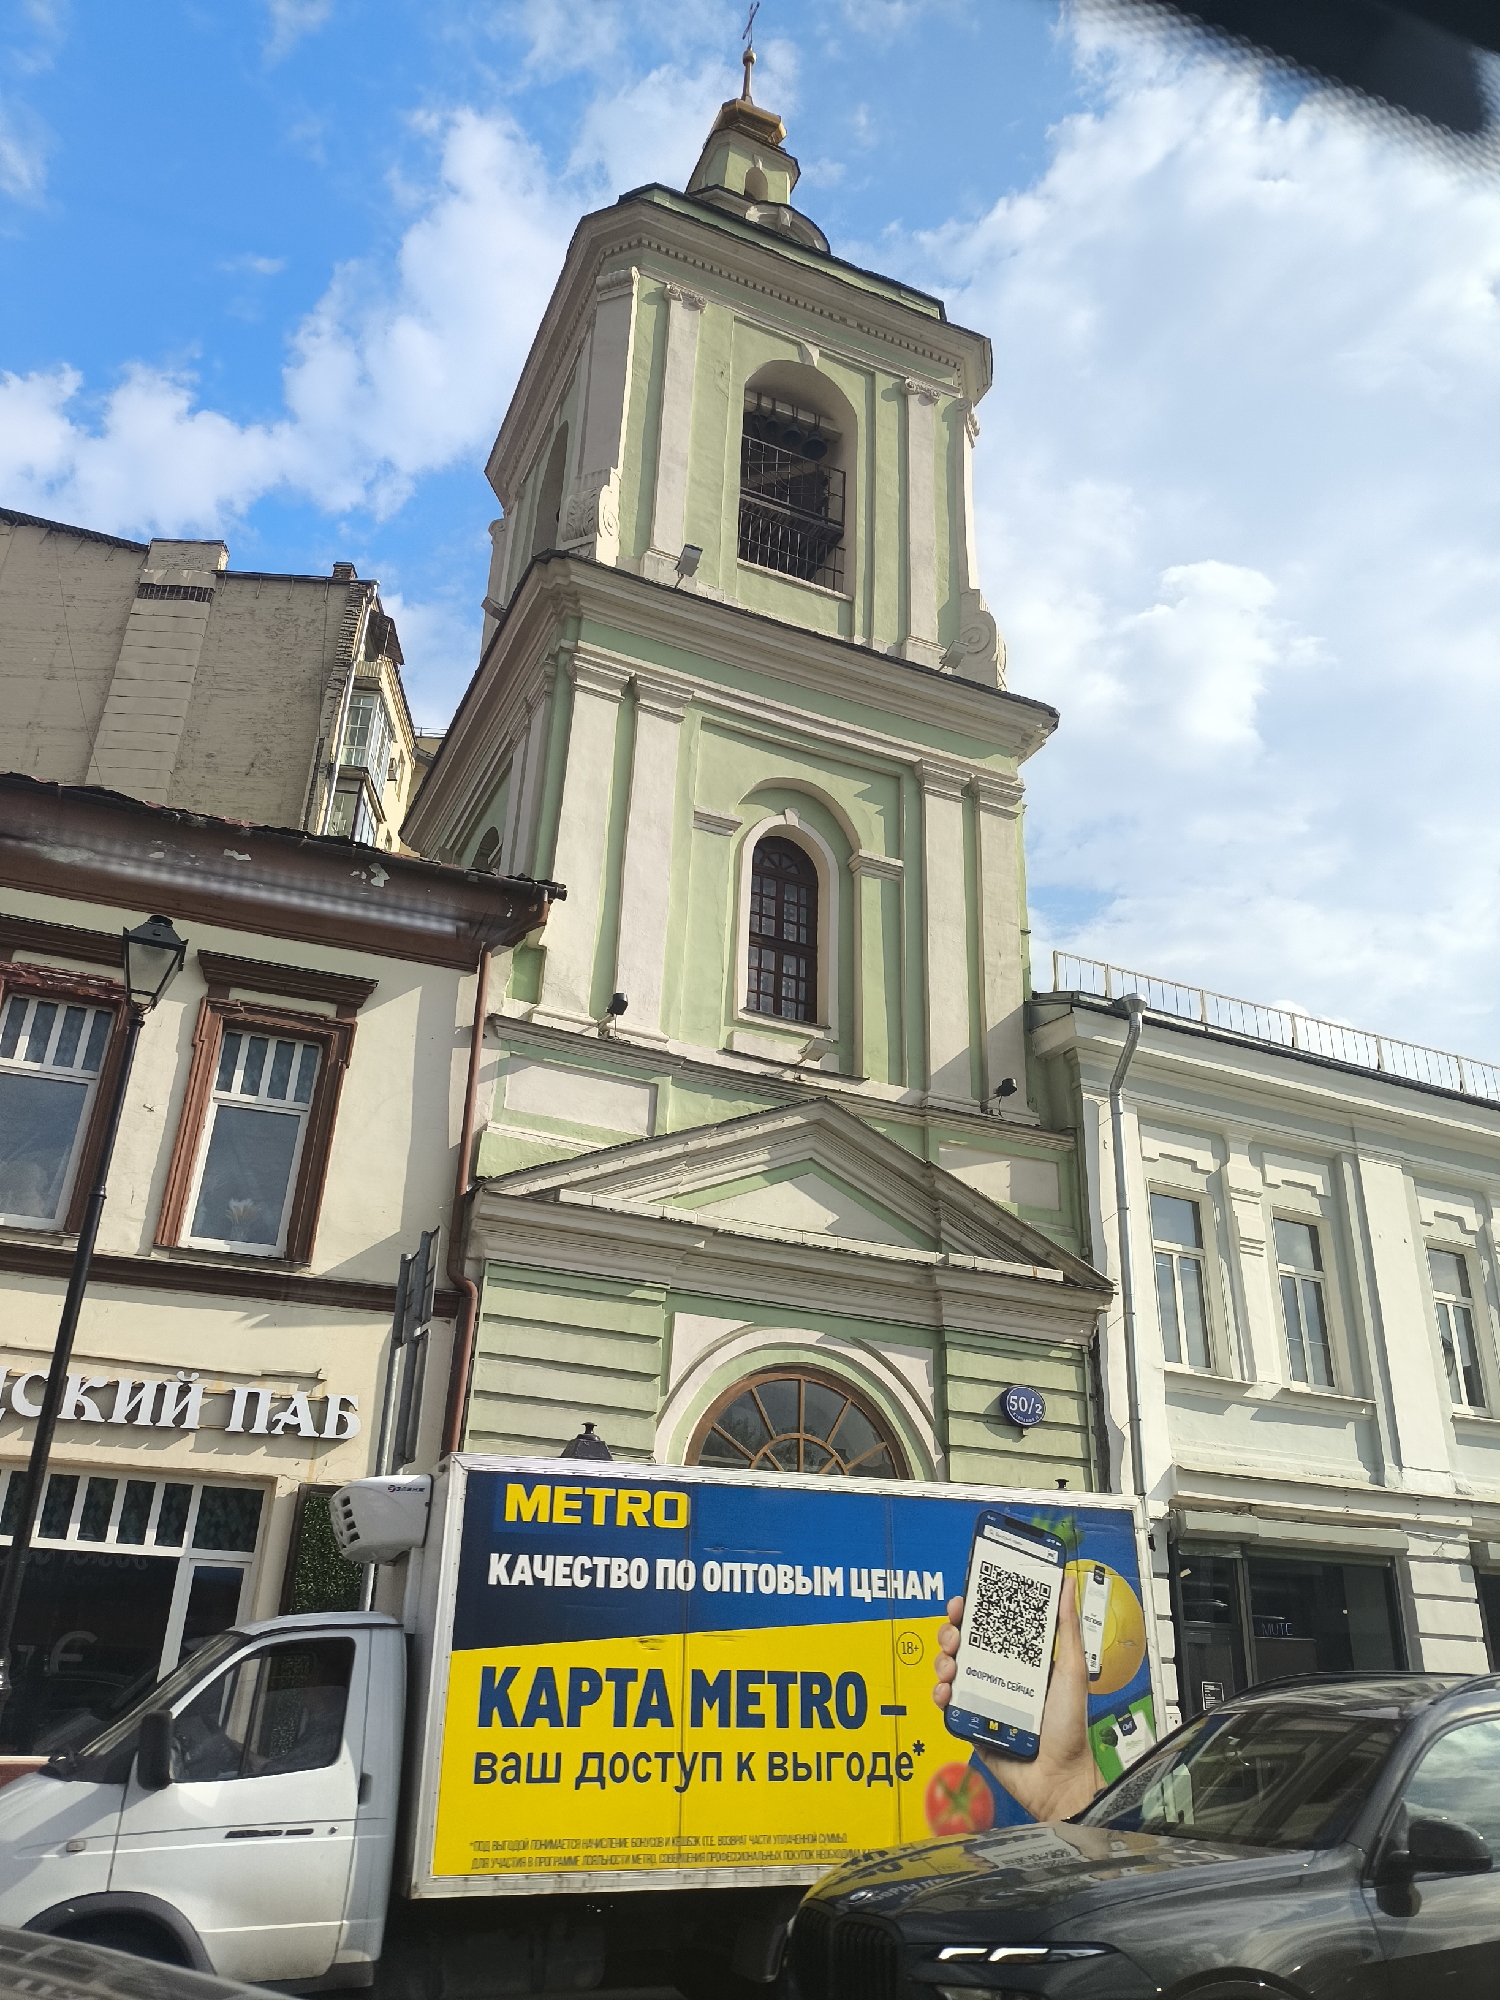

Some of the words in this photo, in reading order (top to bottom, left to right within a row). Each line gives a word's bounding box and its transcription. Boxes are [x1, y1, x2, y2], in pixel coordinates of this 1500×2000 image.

[0, 1367, 206, 1430] СКИЙ
[225, 1387, 361, 1439] ПАБ
[1009, 1395, 1042, 1415] 50/2
[505, 1483, 689, 1529] METRO
[488, 1553, 649, 1589] КАЧЕСТВО
[655, 1558, 696, 1592] ПО
[702, 1560, 844, 1597] ОПТОВЫМ
[850, 1567, 945, 1603] ЦЕНАМ
[901, 1641, 920, 1655] 18+
[1262, 1622, 1293, 1636] MUTE
[477, 1665, 675, 1728] КАРТА
[690, 1668, 868, 1730] METRO
[966, 1666, 1006, 1688] ОФОРМИТЬ
[1006, 1680, 1034, 1698] СЕЙЧАС
[473, 1751, 562, 1785] ваш
[574, 1751, 723, 1794] доступ
[736, 1751, 756, 1782] к
